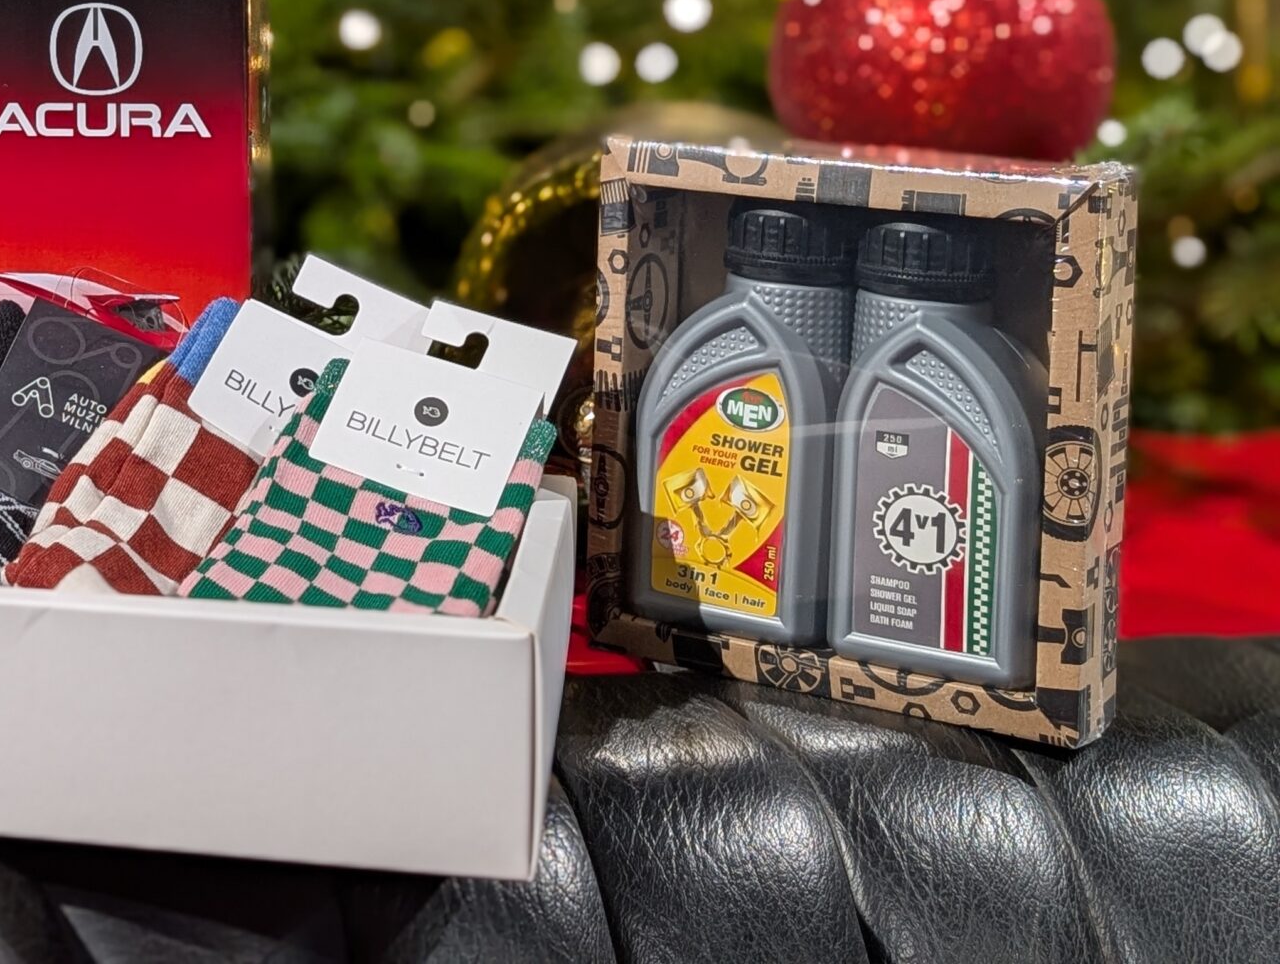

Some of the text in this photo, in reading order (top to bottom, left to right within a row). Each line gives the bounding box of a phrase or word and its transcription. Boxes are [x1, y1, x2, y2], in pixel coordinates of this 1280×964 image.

[69, 392, 108, 415] AUTO
[726, 399, 772, 429] MEN
[346, 410, 492, 471] BILLYBELT
[710, 433, 785, 458] SHOWER
[883, 433, 902, 444] 250
[692, 444, 738, 460] FOR YOUR
[699, 456, 737, 469] ENERGY
[740, 455, 784, 478] GEL
[764, 545, 777, 581] 250 ml
[870, 575, 910, 590] SHAMPOO
[665, 578, 766, 608] body face hair
[870, 588, 917, 605] SHOWER GEL
[870, 601, 918, 618] LIQUID SOAP
[870, 614, 914, 630] BATH FOAM
